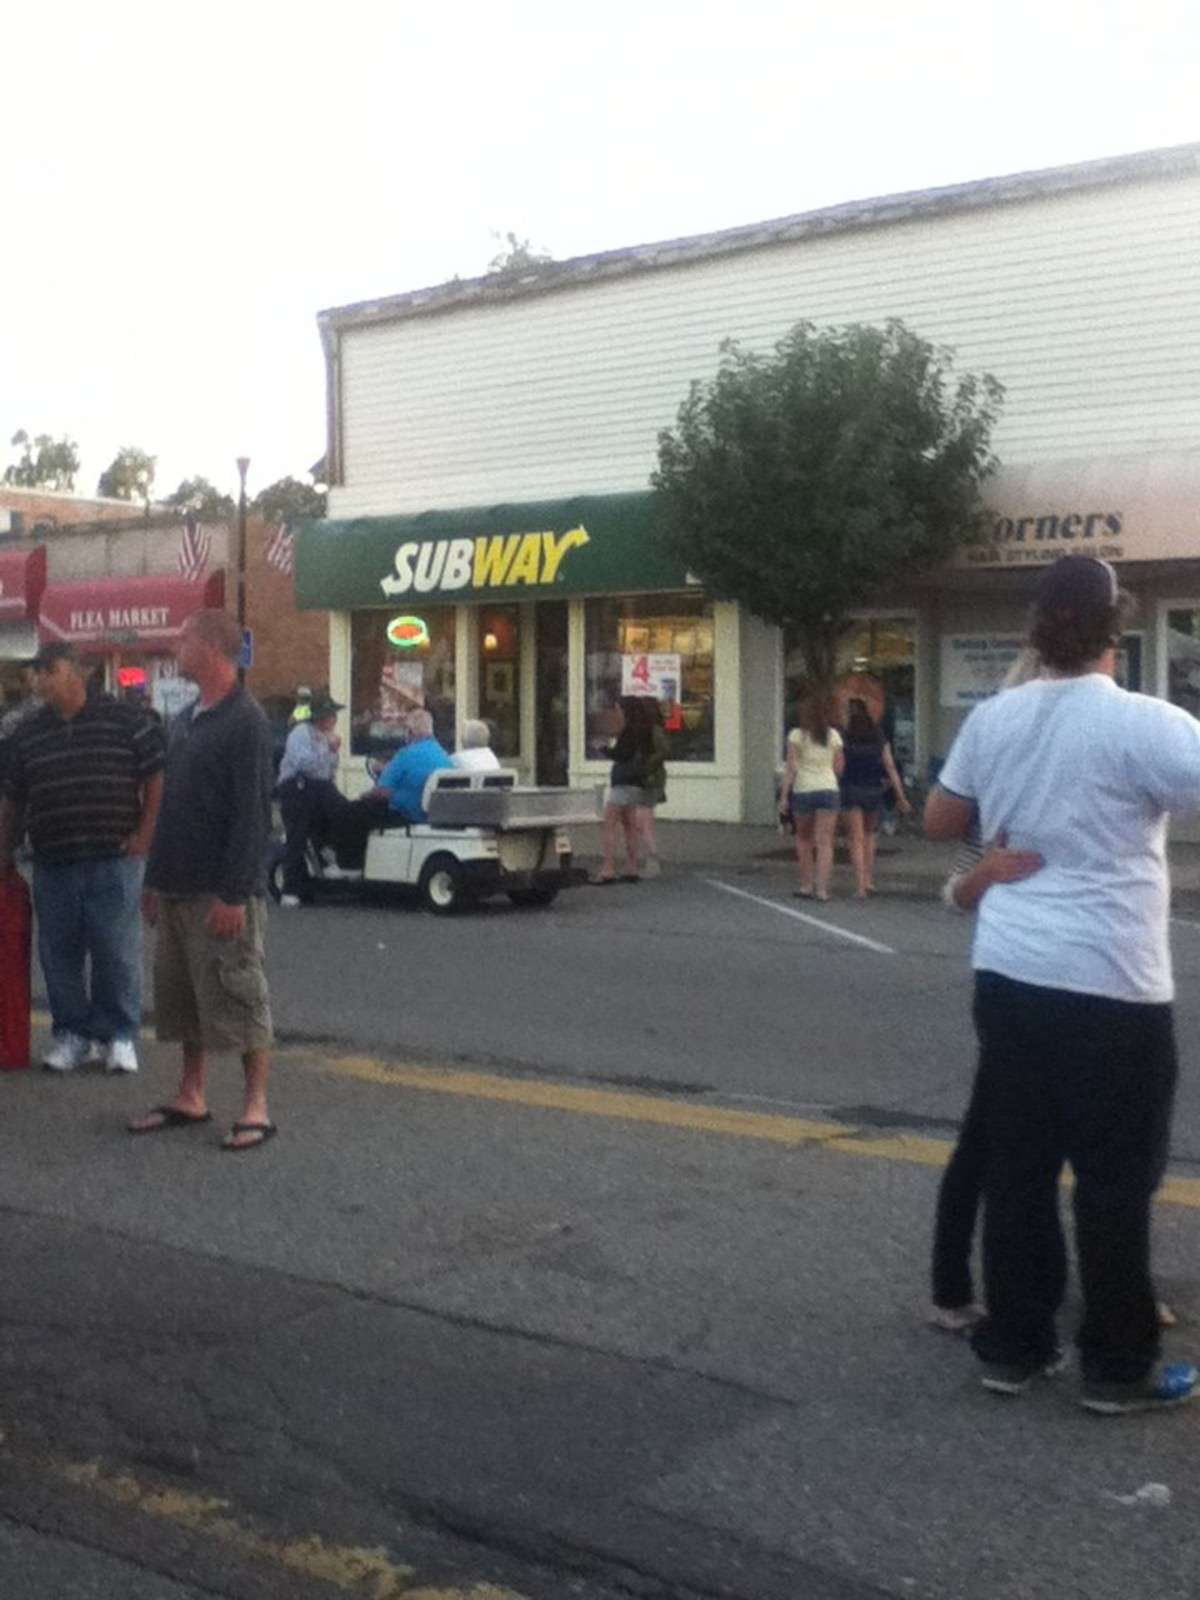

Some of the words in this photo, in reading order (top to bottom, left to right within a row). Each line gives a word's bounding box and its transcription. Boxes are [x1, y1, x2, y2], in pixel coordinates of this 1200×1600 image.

[380, 525, 590, 596] SUBWAY
[70, 610, 103, 630] FLEA
[108, 607, 170, 628] MARKET
